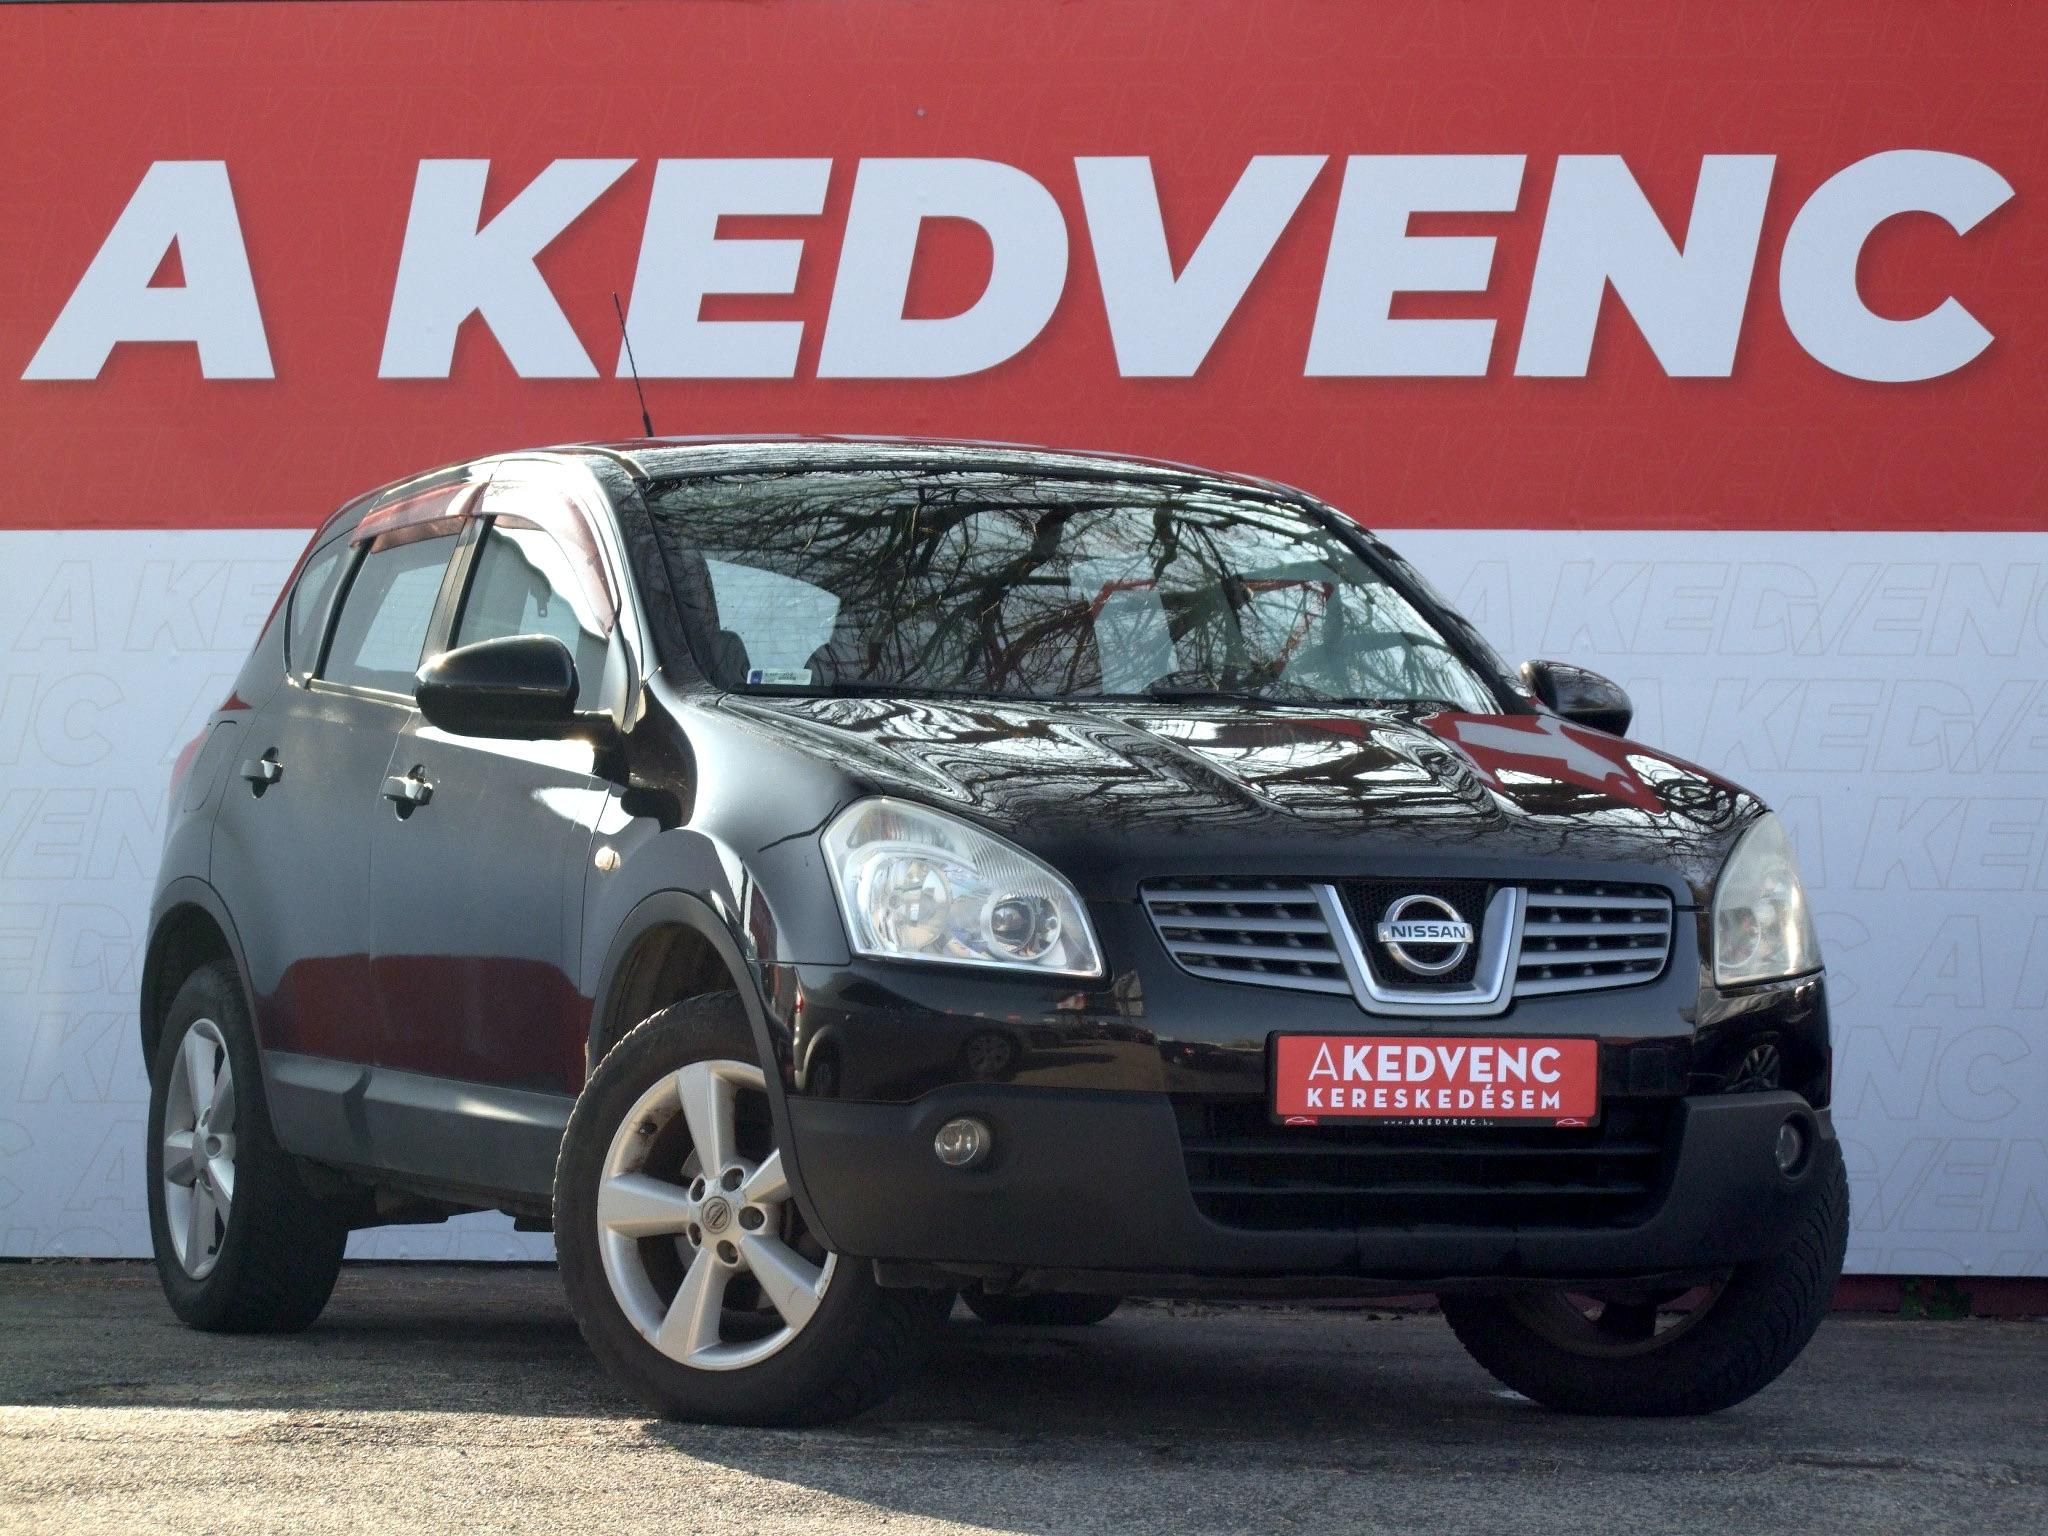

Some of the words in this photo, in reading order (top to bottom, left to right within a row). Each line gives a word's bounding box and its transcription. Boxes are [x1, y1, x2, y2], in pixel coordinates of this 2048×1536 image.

[22, 160, 277, 382] A
[377, 148, 2014, 383] KEDVENC
[11, 560, 98, 652] A
[1390, 925, 1467, 939] NISSAN
[1306, 1084, 1561, 1109] KERESKEDÉSEM
